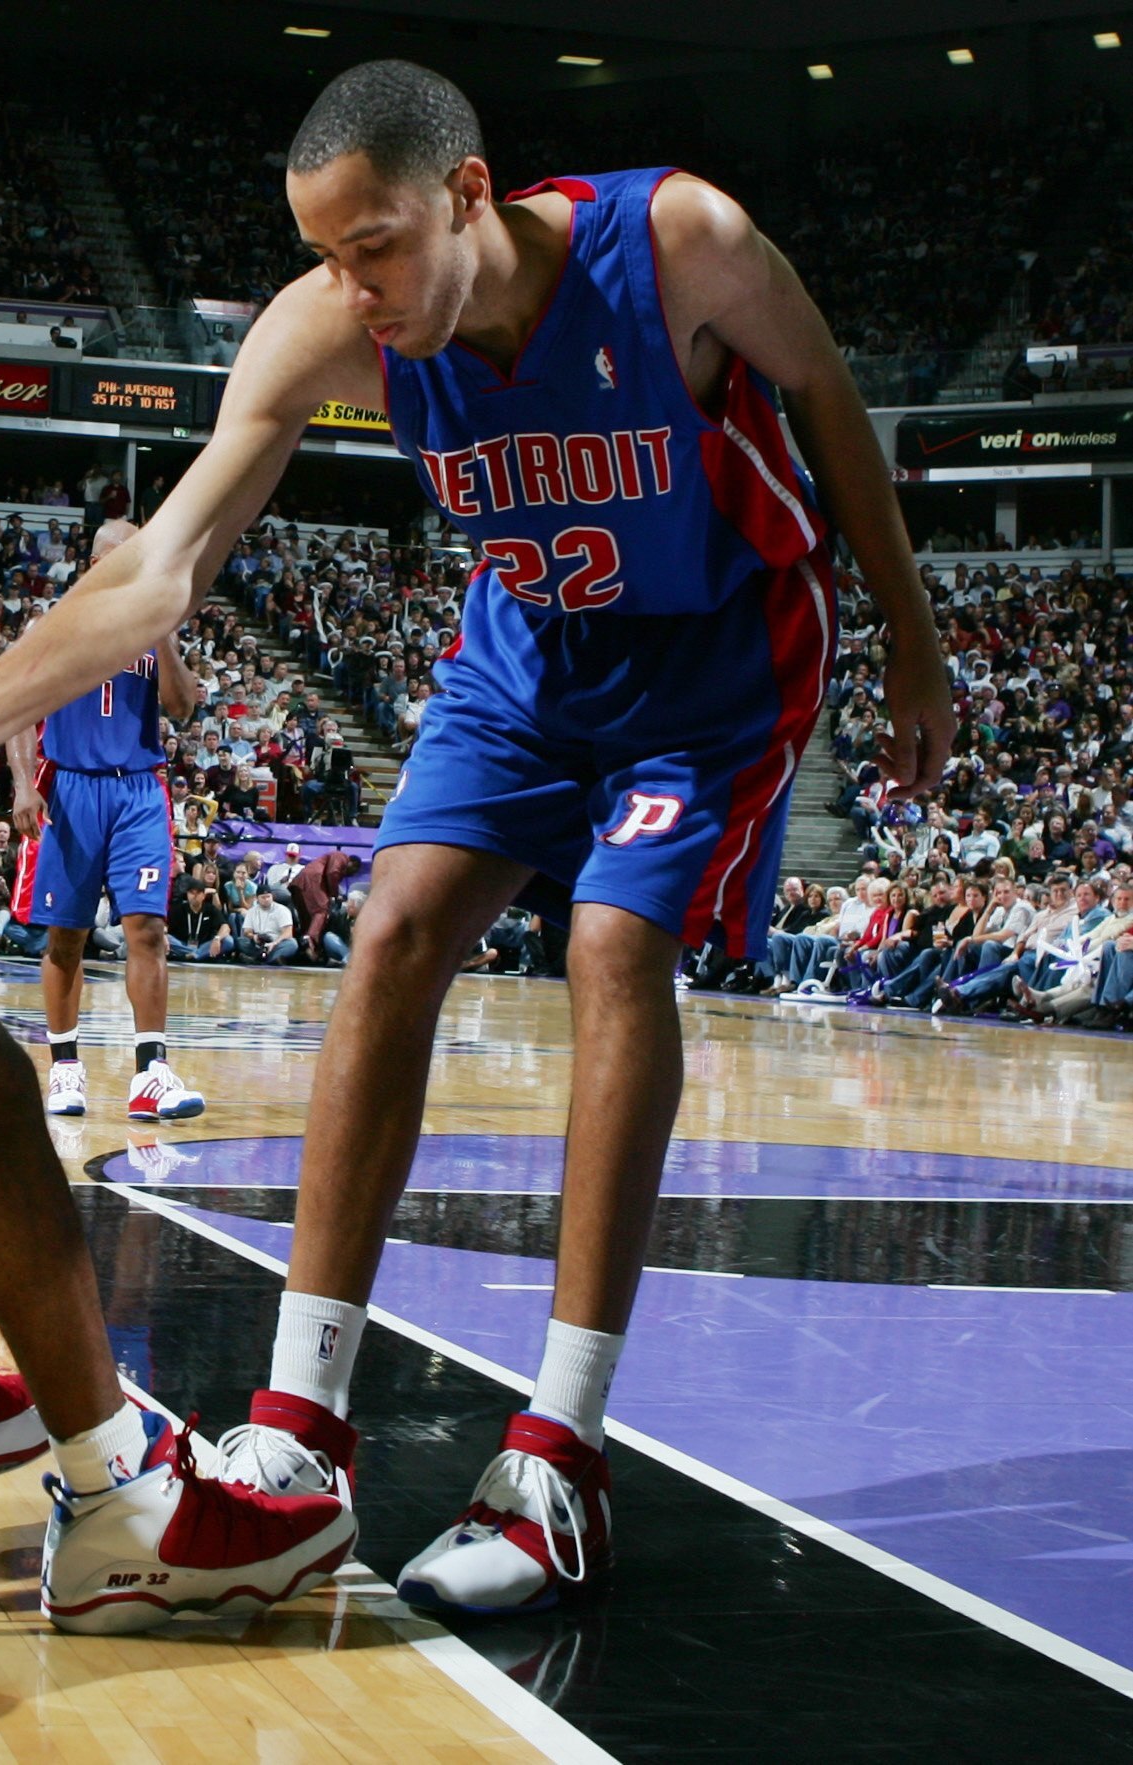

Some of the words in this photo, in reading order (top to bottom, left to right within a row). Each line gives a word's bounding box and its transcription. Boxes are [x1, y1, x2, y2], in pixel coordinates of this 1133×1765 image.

[91, 394, 107, 405] 35
[110, 395, 132, 407] PTS
[140, 397, 151, 409] 10
[154, 398, 176, 410] AST
[417, 426, 671, 517] DETROIT
[482, 526, 624, 612] 22
[106, 1573, 142, 1587] RIP
[146, 1572, 170, 1586] 32
